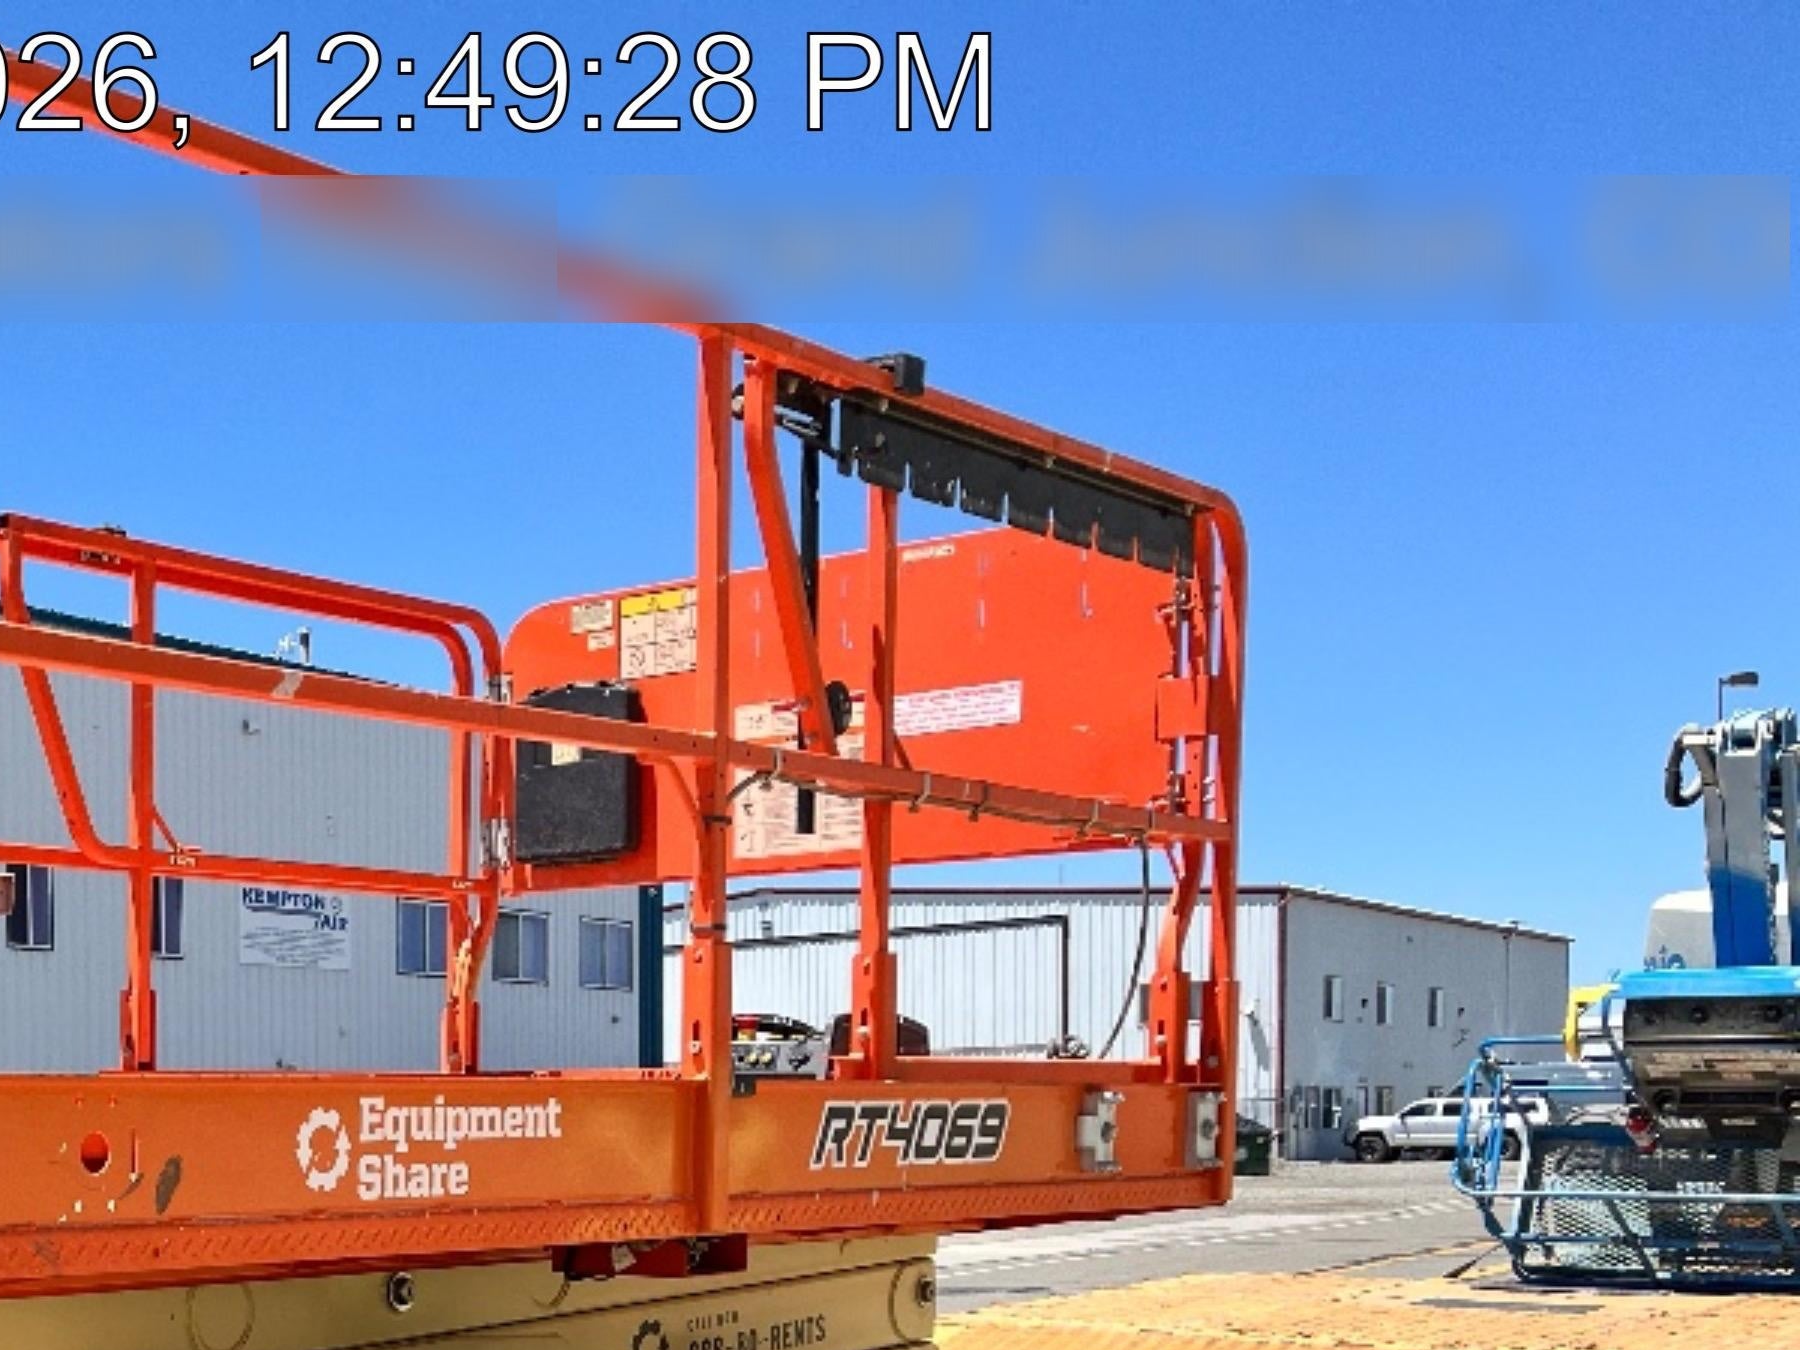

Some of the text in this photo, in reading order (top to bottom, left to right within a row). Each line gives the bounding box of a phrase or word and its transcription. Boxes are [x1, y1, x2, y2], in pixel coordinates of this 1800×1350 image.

[358, 1094, 562, 1152] Equipment
[809, 1098, 1011, 1171] RT4069
[357, 1153, 469, 1200] Share
